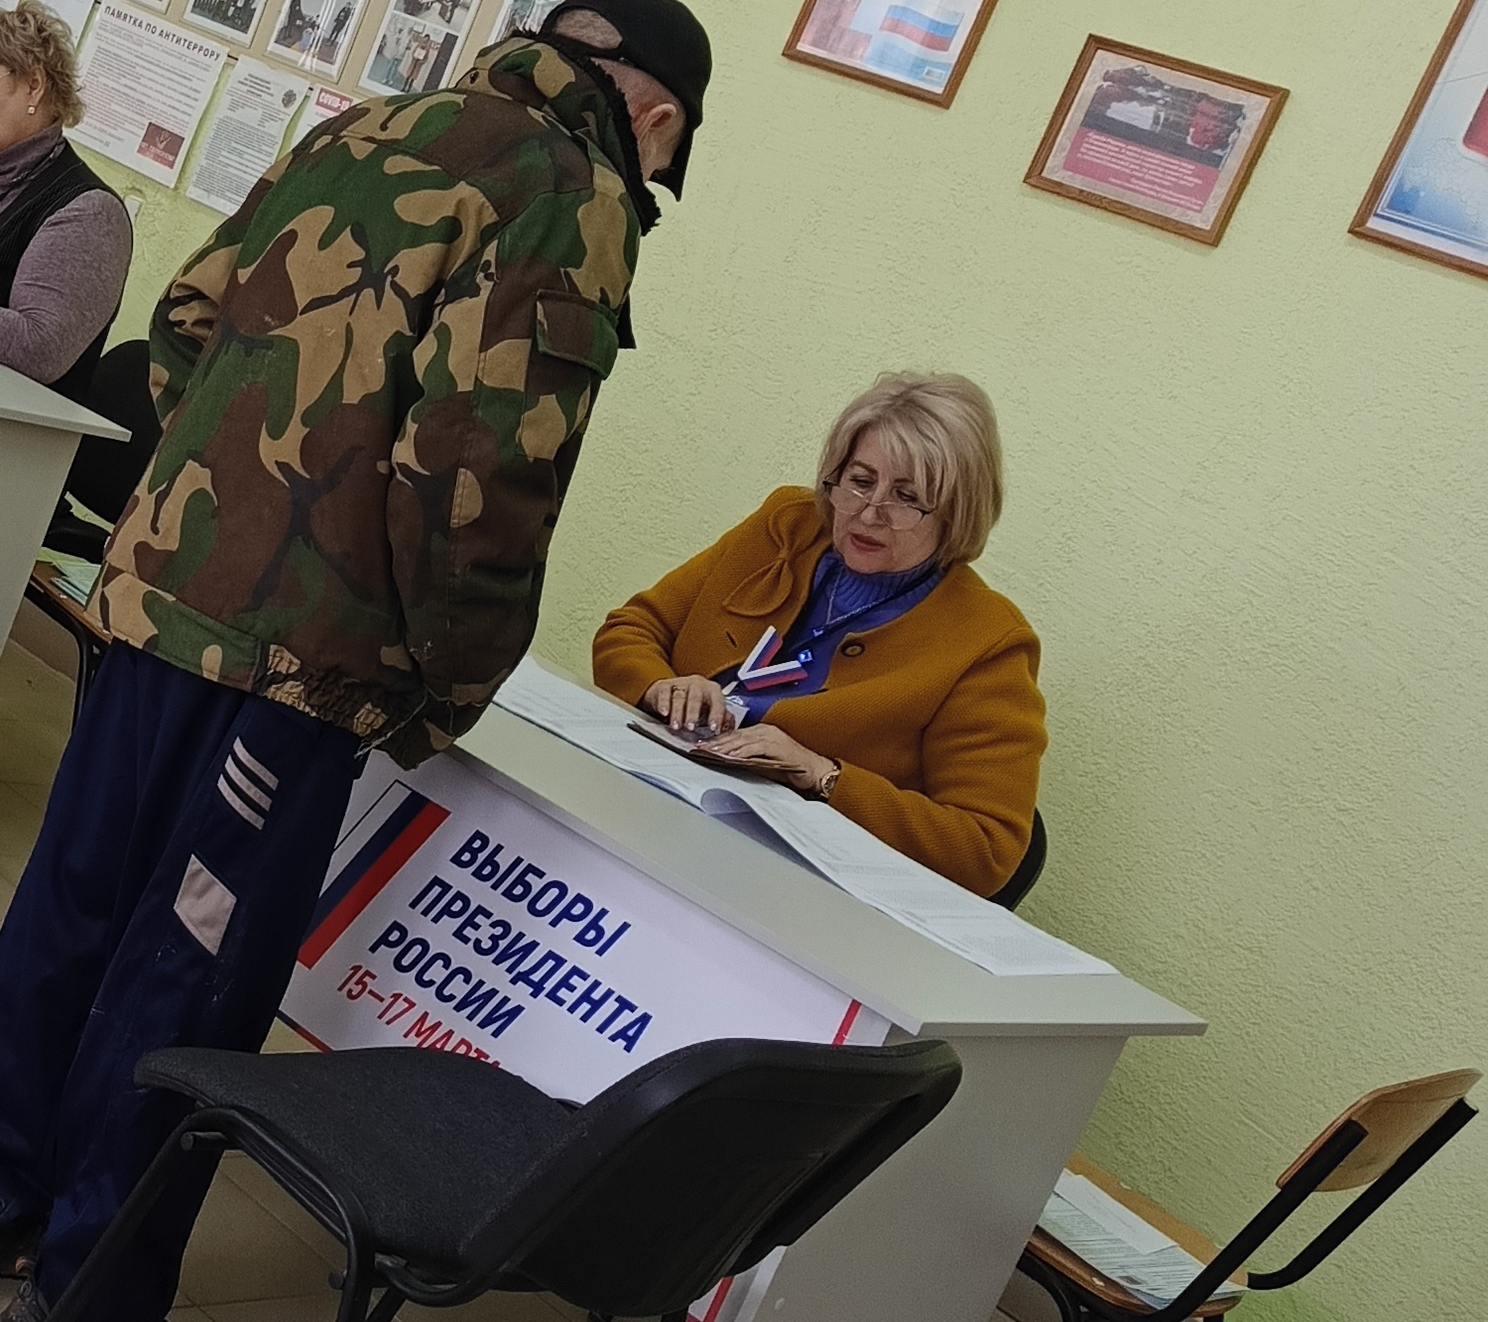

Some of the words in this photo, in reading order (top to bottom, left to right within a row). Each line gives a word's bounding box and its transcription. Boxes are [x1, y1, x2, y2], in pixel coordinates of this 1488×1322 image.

[104, 4, 144, 30] ПАМЯТКА
[144, 22, 158, 35] ПО
[158, 29, 222, 62] АНТИТЕРРОРУ
[449, 829, 632, 958] ВЫБОРЫ
[368, 919, 526, 1039] РОССИИ
[408, 874, 654, 1054] ПРЕЗИДЕНТА
